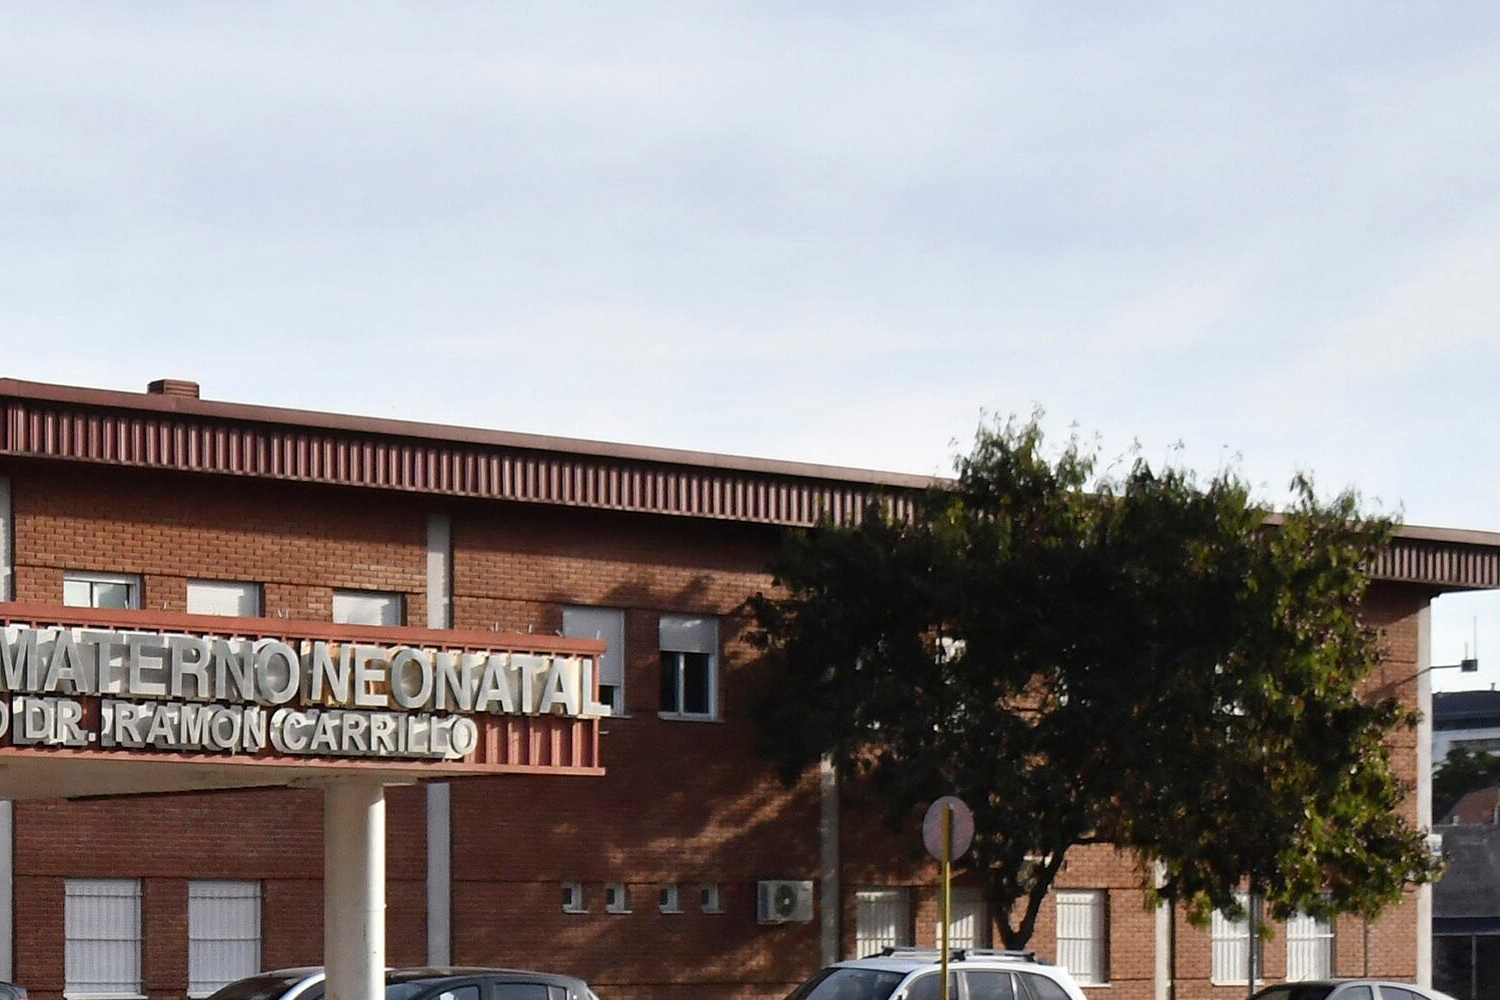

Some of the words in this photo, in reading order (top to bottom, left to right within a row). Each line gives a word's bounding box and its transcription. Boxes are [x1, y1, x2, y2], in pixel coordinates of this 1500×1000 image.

[311, 640, 611, 717] NEONATAL
[25, 701, 96, 742] DR.
[115, 704, 266, 750] RAMON
[283, 713, 478, 756] CARRILLO
